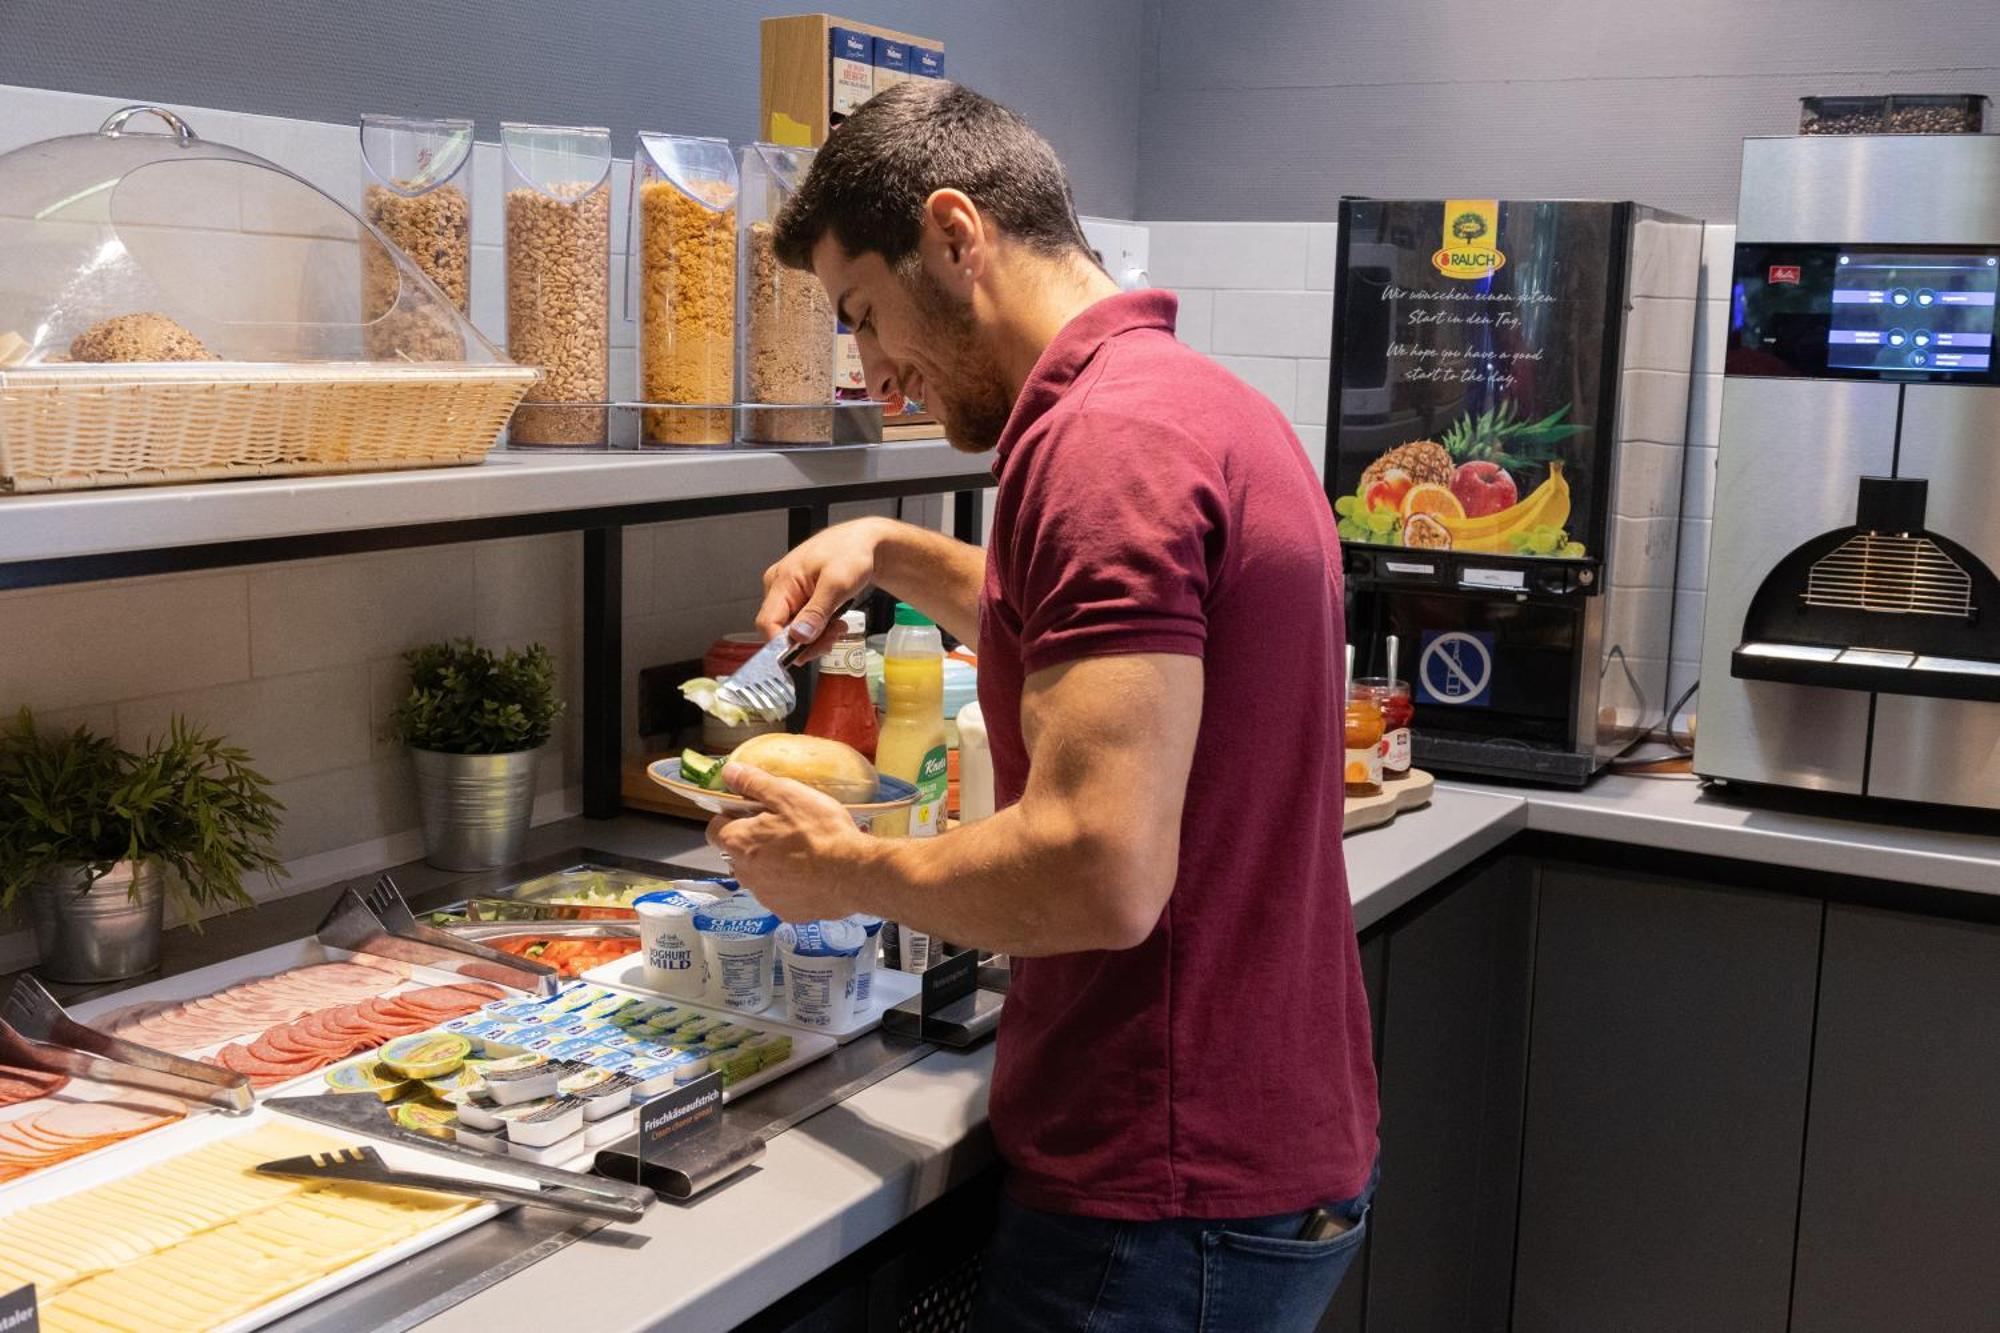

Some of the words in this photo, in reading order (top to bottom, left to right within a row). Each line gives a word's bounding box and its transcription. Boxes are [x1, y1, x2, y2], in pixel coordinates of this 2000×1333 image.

[1451, 253, 1496, 266] RAUCH
[1381, 285, 1407, 300] Wir
[1409, 287, 1471, 301] wünschen
[1474, 292, 1513, 301] einen
[1407, 308, 1446, 326] Start
[1447, 312, 1463, 324] in
[1465, 312, 1494, 325] den
[1386, 341, 1407, 357] We
[1409, 344, 1438, 361] hope
[1440, 349, 1461, 361] you
[1464, 346, 1496, 359] have
[1513, 348, 1544, 364] good
[1405, 367, 1440, 381] start
[1442, 370, 1458, 382] to
[1460, 369, 1485, 382] the
[650, 959, 692, 970] MILD
[644, 1089, 719, 1133] Frischkäseaufstrich
